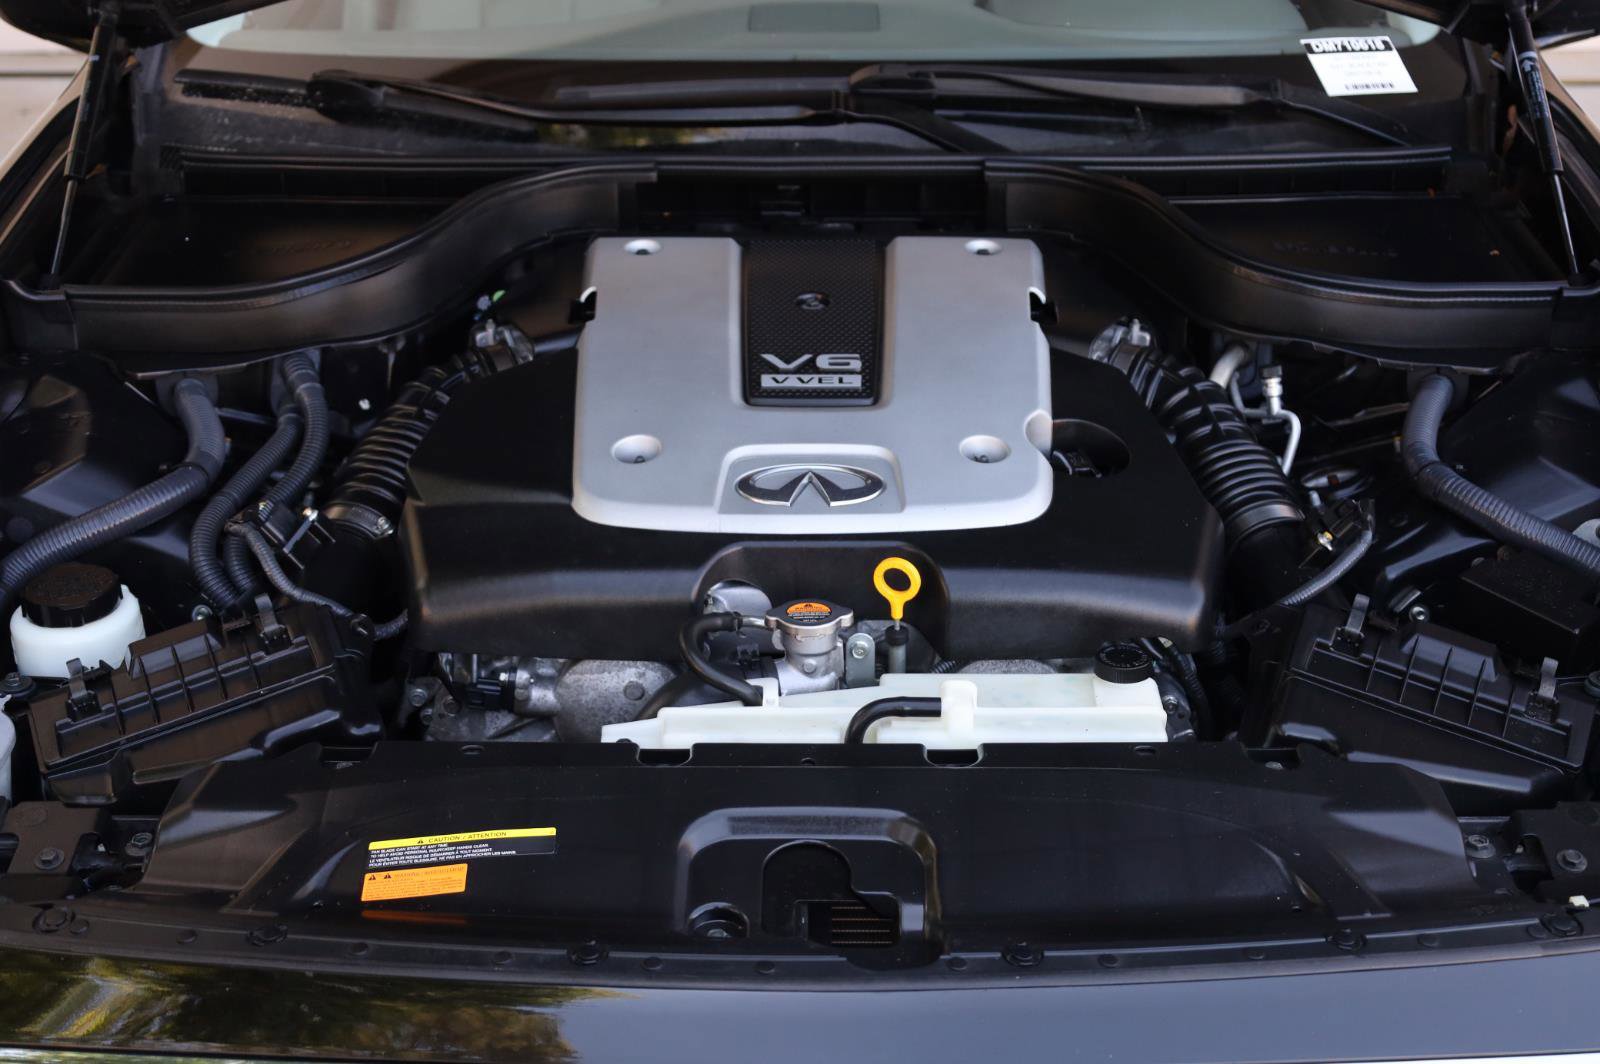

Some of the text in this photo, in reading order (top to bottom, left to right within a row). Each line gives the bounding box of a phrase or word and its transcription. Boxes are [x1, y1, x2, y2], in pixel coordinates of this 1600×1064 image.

[760, 353, 863, 372] V6
[770, 376, 854, 385] VVEL
[428, 835, 461, 843] CAUTION
[467, 832, 507, 840] ATTENTION
